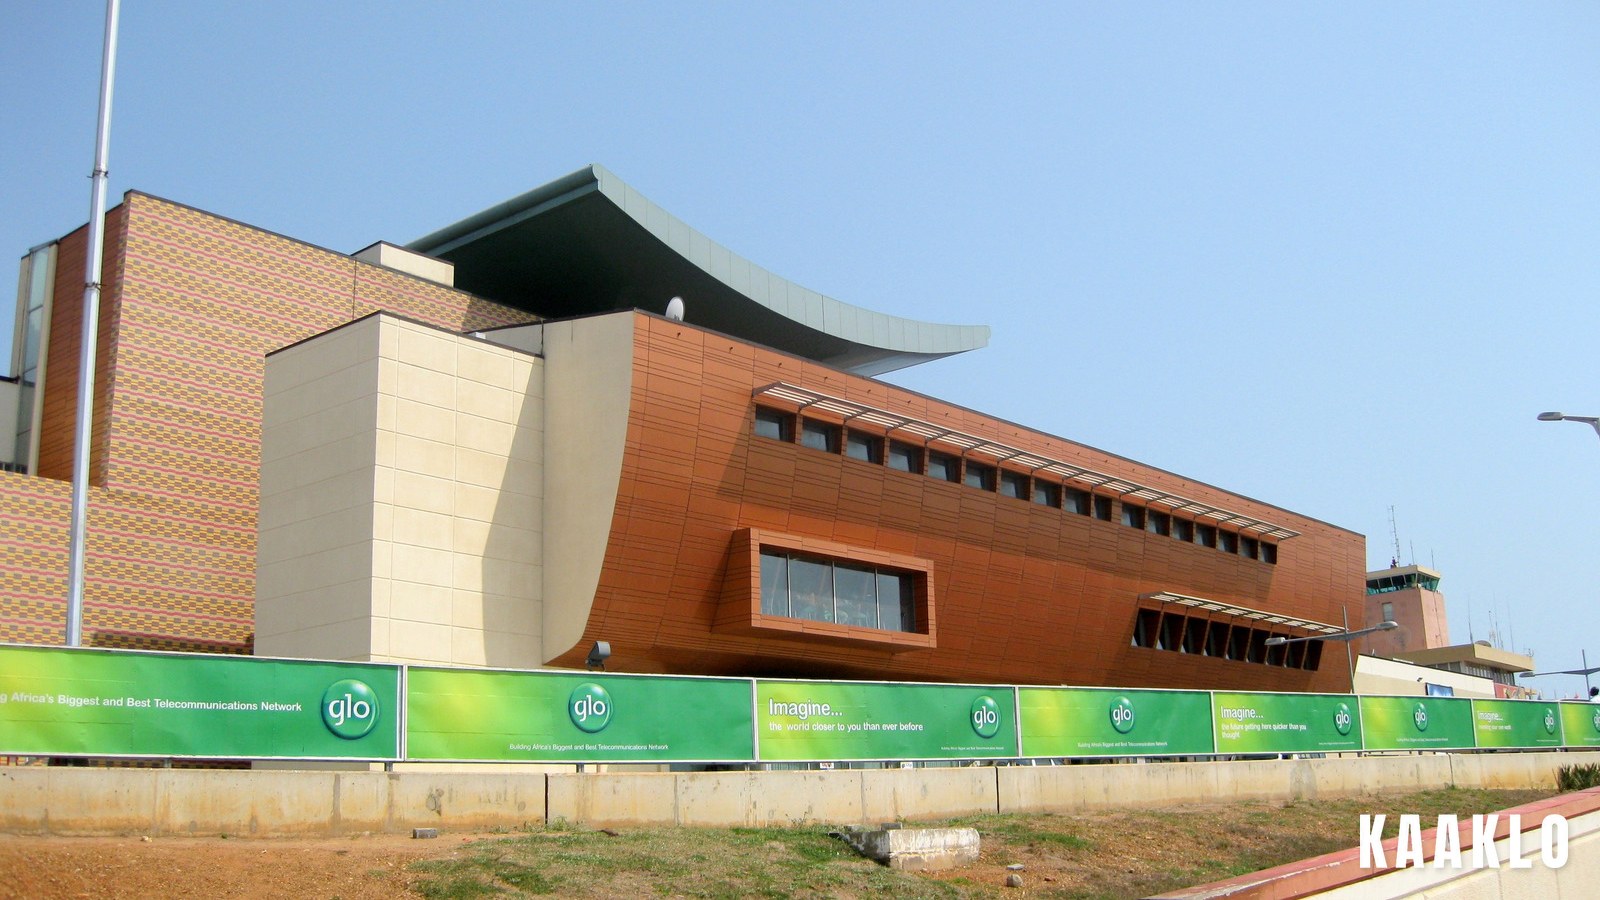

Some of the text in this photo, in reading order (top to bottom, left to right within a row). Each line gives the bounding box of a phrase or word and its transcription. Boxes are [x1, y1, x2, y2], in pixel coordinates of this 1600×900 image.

[12, 692, 54, 704] Africa's
[58, 694, 100, 708] Biggest
[103, 697, 123, 707] and
[127, 698, 151, 708] Best
[154, 698, 258, 711] Telecommunications
[261, 701, 302, 712] Network
[328, 693, 370, 725] glo
[574, 694, 606, 722] glo
[768, 698, 843, 719] Imagine...
[974, 705, 996, 729] glo
[1112, 704, 1132, 726] glo
[1220, 706, 1264, 721] Imagine...
[1335, 710, 1350, 729] glo
[1414, 711, 1426, 724] glo
[769, 722, 924, 733] the world closer to you than ever before
[1261, 722, 1272, 730] here
[1272, 723, 1288, 731] quicker
[1288, 722, 1299, 730] than
[1299, 724, 1307, 732] you
[509, 743, 532, 752] Building
[532, 743, 551, 751] Africa's
[552, 743, 574, 752] Biggest
